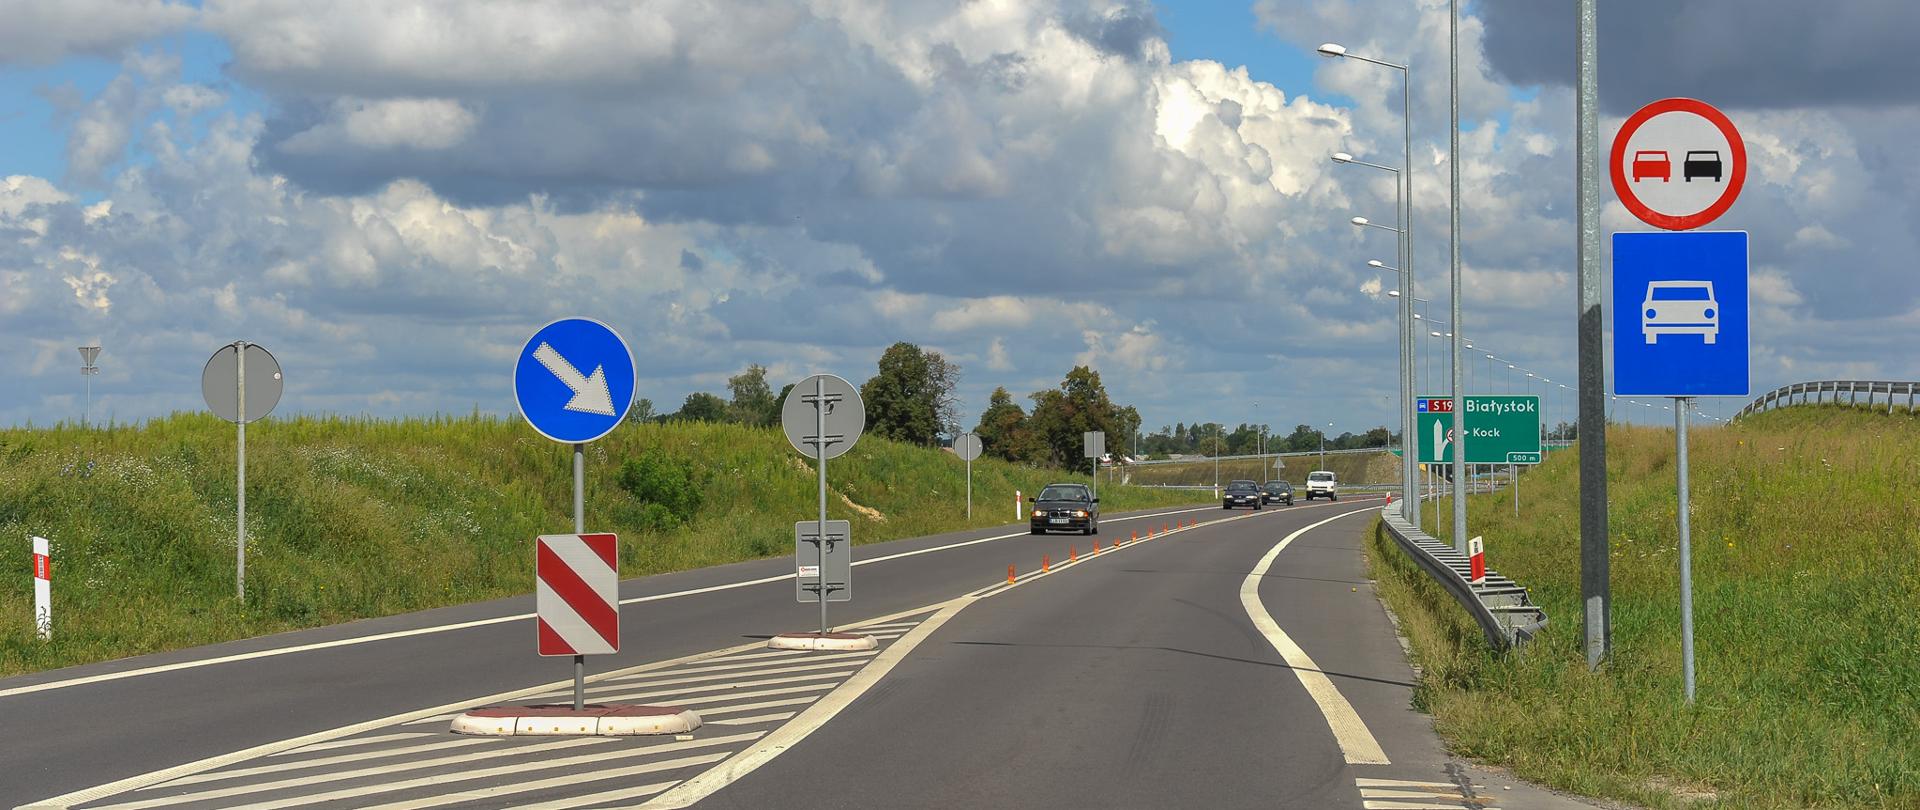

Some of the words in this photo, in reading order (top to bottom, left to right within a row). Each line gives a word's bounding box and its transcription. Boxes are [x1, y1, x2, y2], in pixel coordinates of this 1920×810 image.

[1433, 401, 1440, 410] S
[1442, 401, 1453, 410] 19
[1466, 400, 1534, 415] Białystok
[1473, 428, 1500, 437] Kock
